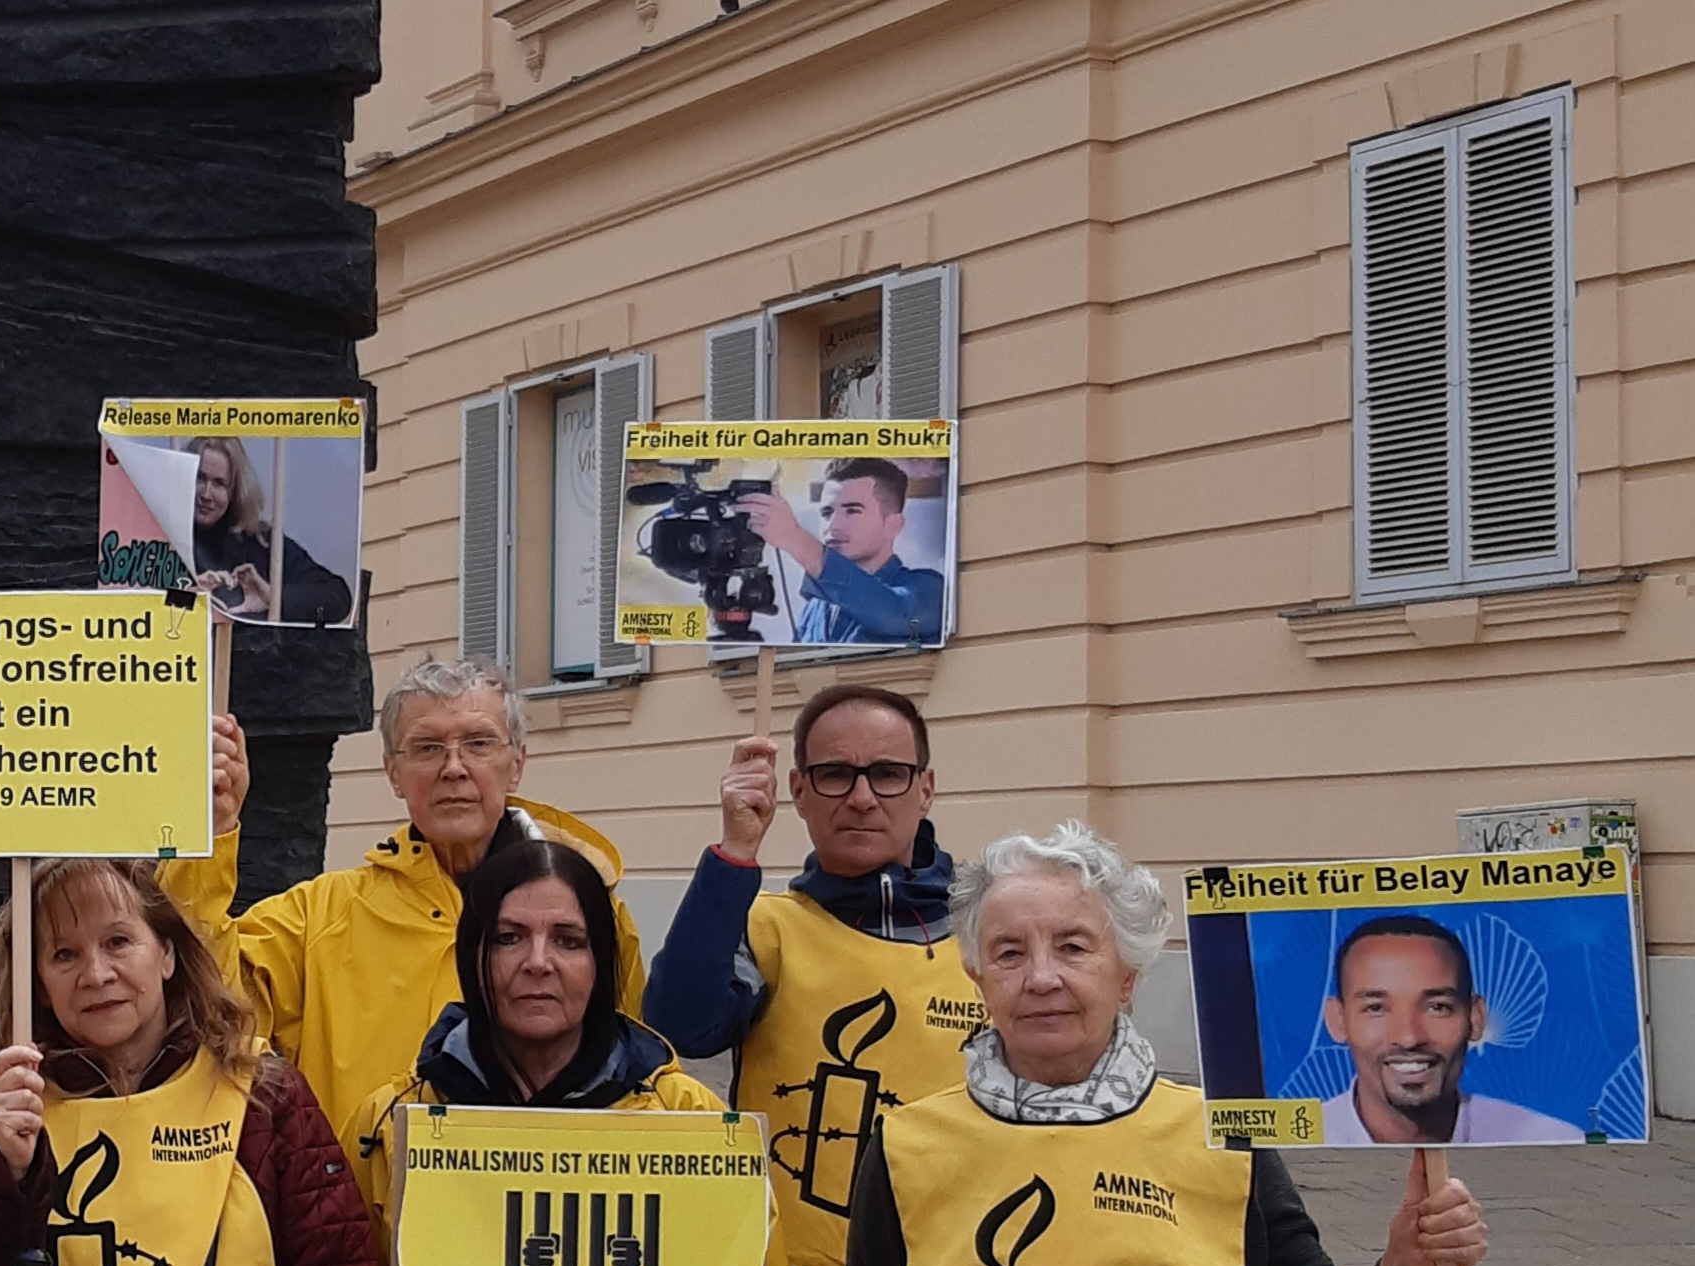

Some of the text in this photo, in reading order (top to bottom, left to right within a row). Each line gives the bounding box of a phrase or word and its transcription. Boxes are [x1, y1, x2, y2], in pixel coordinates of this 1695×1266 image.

[104, 407, 360, 427] Release Maria Ponomarenko
[626, 428, 951, 449] Freiheit für Qahraman Shukri
[84, 611, 152, 640] und
[622, 612, 673, 626] AMNESTY
[17, 698, 70, 727] ein
[20, 787, 96, 806] AEMR
[1186, 858, 1616, 900] Freiheit für Belay Manaye
[926, 996, 990, 1020] AMNES
[1211, 1109, 1276, 1126] AMNESTY
[151, 1121, 231, 1148] AMNESTY
[152, 1143, 234, 1162] INTERNATIONAL
[552, 1152, 581, 1174] IST
[588, 1153, 630, 1175] KEIN
[1093, 1171, 1175, 1210] AMNESTY
[1094, 1196, 1179, 1227] INTERNATIONAL
